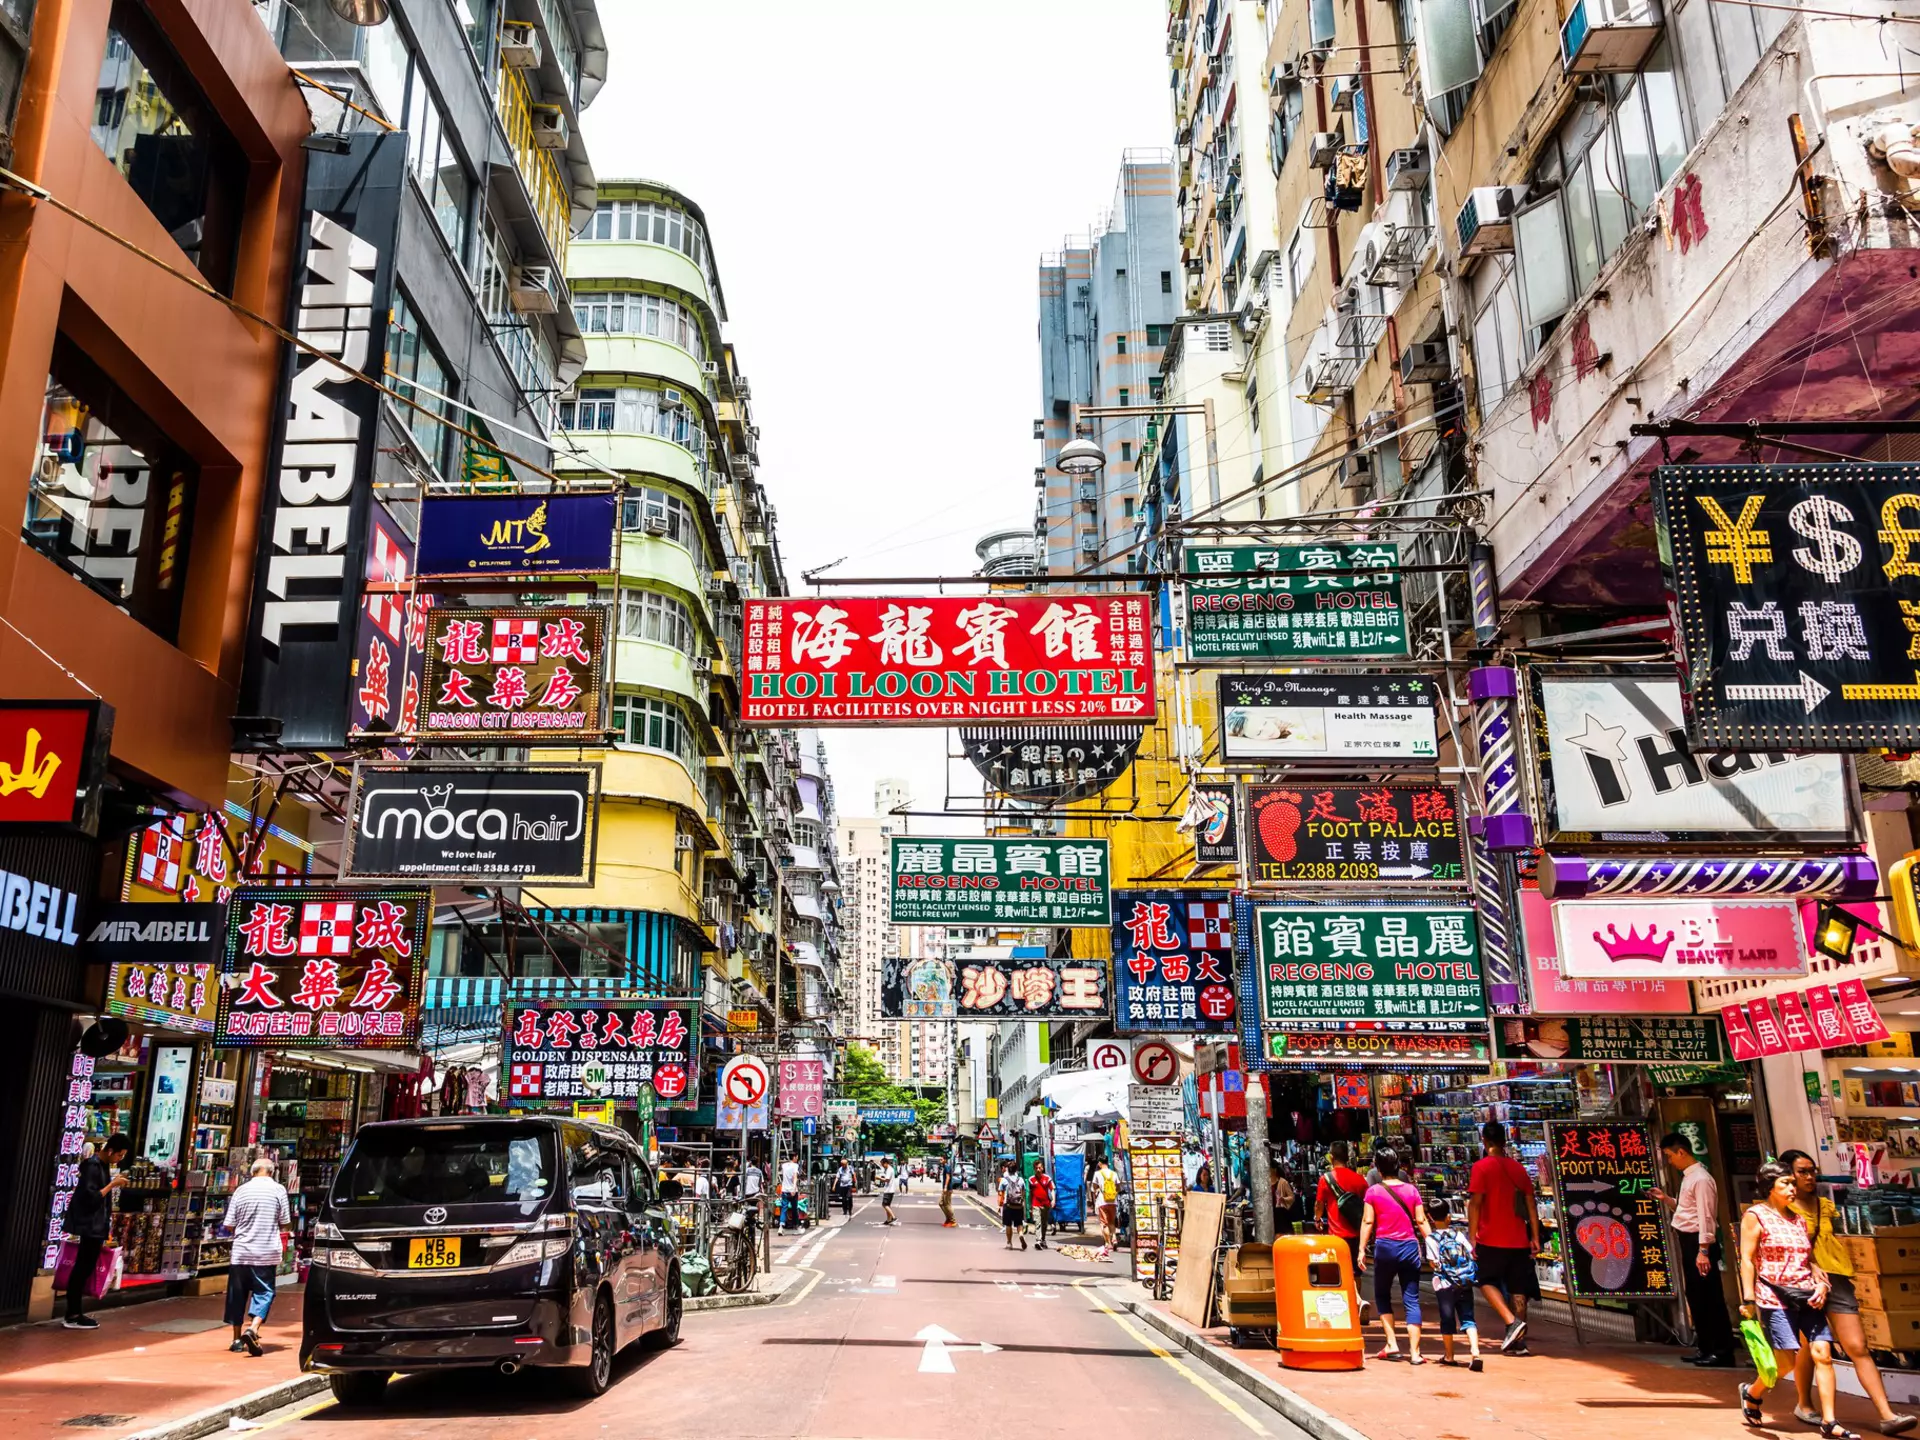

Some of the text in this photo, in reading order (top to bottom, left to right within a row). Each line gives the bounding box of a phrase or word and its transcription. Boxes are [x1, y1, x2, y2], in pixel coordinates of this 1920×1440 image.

[1788, 494, 1862, 583] $
[1192, 547, 1395, 590] 麗晶賓館
[1193, 592, 1398, 611] REGENG HOTEL
[1242, 613, 1289, 629] 酒店設備
[1292, 612, 1338, 628] 豪華套房
[748, 605, 765, 671] 酒店設備
[766, 605, 783, 671] 純粹租房
[791, 602, 1104, 670] 海龍賓館
[1108, 601, 1126, 666] 全日特平
[1126, 601, 1145, 667] 時租過夜
[1195, 633, 1220, 641] HOTEL
[1221, 633, 1255, 641] FACILITY
[1195, 642, 1259, 652] HOTEL FREE WIFI
[437, 667, 582, 709] 大藥房
[749, 669, 1147, 699] HOI LOON HOTEL
[1284, 681, 1337, 696] Massage
[748, 703, 809, 717] HOTEL
[812, 702, 912, 717] FACILITEIS
[915, 701, 964, 715] OVER
[968, 701, 1027, 715] NIGHT
[1032, 701, 1076, 714] LESS
[1080, 700, 1107, 713] 20%
[1334, 712, 1413, 721] Health Massage
[429, 711, 586, 728] DRAGON CITY DISPENSARY
[1413, 741, 1431, 749] 1/F
[376, 807, 568, 841] moca hair
[1307, 822, 1457, 838] FOOT PALACE
[441, 850, 497, 859] We love hair
[1325, 841, 1430, 861] 正宗按摩
[399, 863, 536, 873] appointment call: 2388 4781
[896, 843, 1104, 877] 麗晶賓館
[1339, 862, 1379, 879] 2093
[1432, 863, 1461, 879] 2/F
[898, 875, 1102, 891] REGENG HOTEL
[945, 889, 992, 902] 酒店設備
[995, 891, 1042, 904] 豪華套房
[1123, 901, 1181, 950] 龍
[1682, 917, 1733, 947] BL
[1676, 948, 1778, 964] BEAUTY LAND
[1127, 951, 1226, 984] 中西大
[1269, 962, 1480, 981] REGENG HOTEL
[236, 959, 401, 1011] 大藥房
[960, 965, 1103, 1010] 沙嗲王
[1128, 985, 1196, 1002] 政府註冊
[1321, 985, 1369, 998] 酒店設備
[1372, 984, 1419, 997] 豪華套房
[1129, 1003, 1197, 1020] 免稅正貨
[1209, 999, 1227, 1017] 正
[1272, 1008, 1310, 1016] HOTEL
[1340, 1007, 1365, 1015] WIFI
[227, 1011, 403, 1036] 政府註冊 信心保證
[1288, 1036, 1471, 1051] FOOT & BODY MASSAGE
[512, 1050, 687, 1062] GOLDEN DISPENSARY LTD.
[1583, 1050, 1709, 1060] HOTEL FREE WIFI
[586, 1068, 606, 1083] 5M
[785, 1063, 819, 1081] $ ¥
[1654, 1068, 1689, 1084] HOTEL
[661, 1077, 678, 1093] 正
[1170, 1088, 1180, 1096] 12
[783, 1096, 797, 1113] £
[802, 1095, 819, 1113] €
[1560, 1160, 1650, 1176] FOOT PALACE
[425, 1238, 446, 1253] WB
[1635, 1199, 1667, 1289] 正宗按摩
[414, 1251, 456, 1266] 4858
